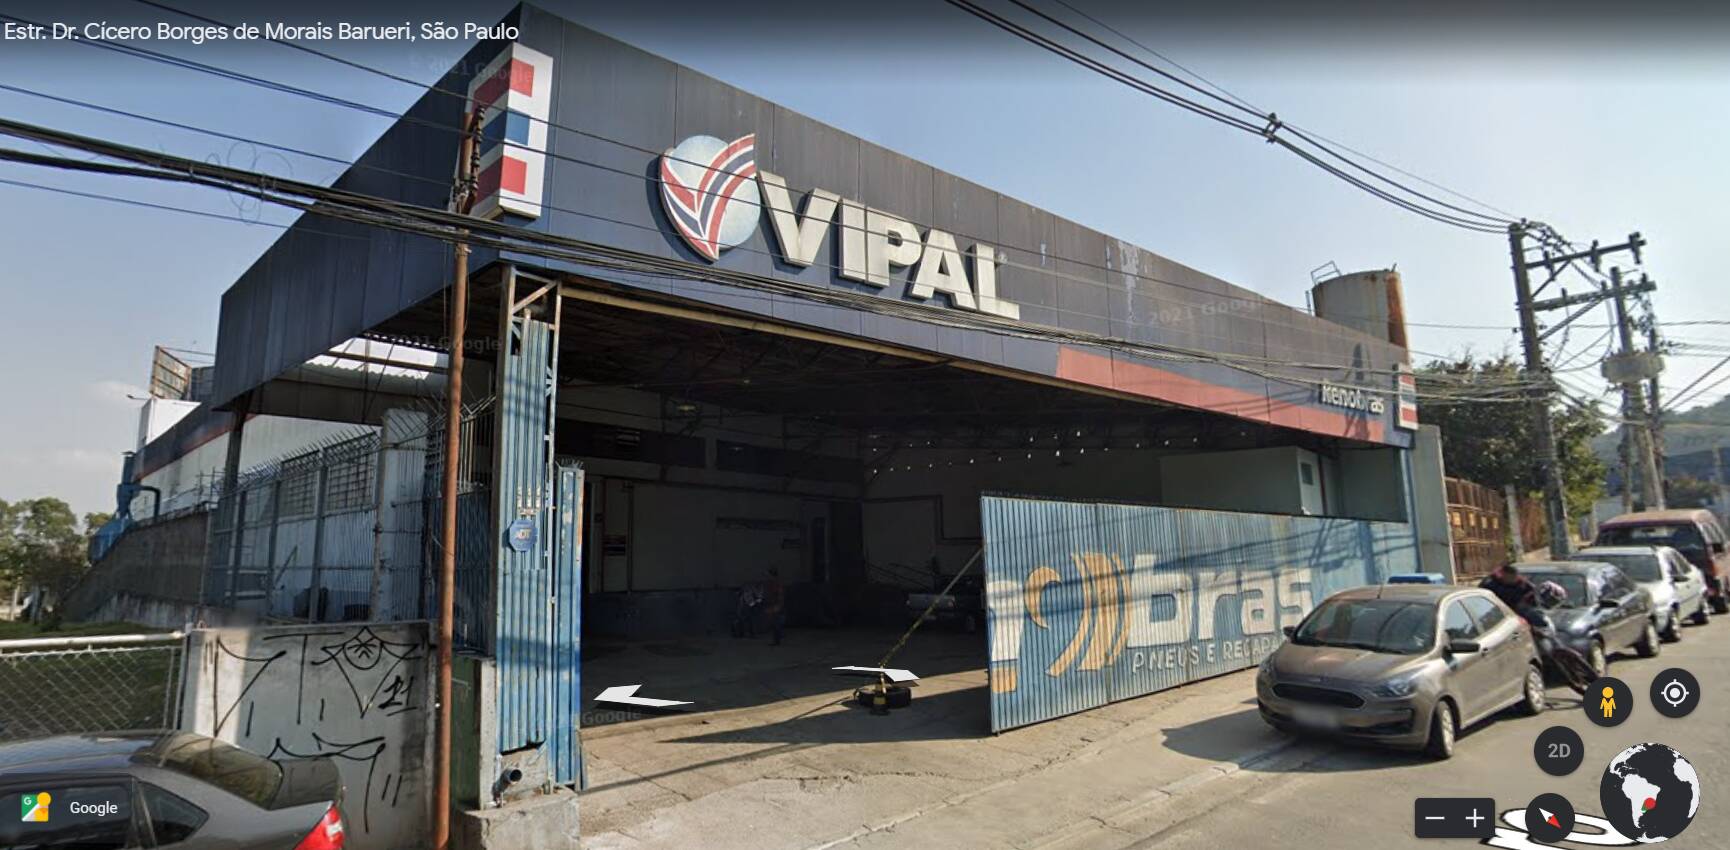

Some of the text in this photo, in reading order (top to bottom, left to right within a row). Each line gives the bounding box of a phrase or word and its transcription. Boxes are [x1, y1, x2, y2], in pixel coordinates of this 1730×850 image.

[758, 170, 1020, 320] VIPAL
[1132, 645, 1200, 675] PNEUS
[1206, 643, 1216, 663] E
